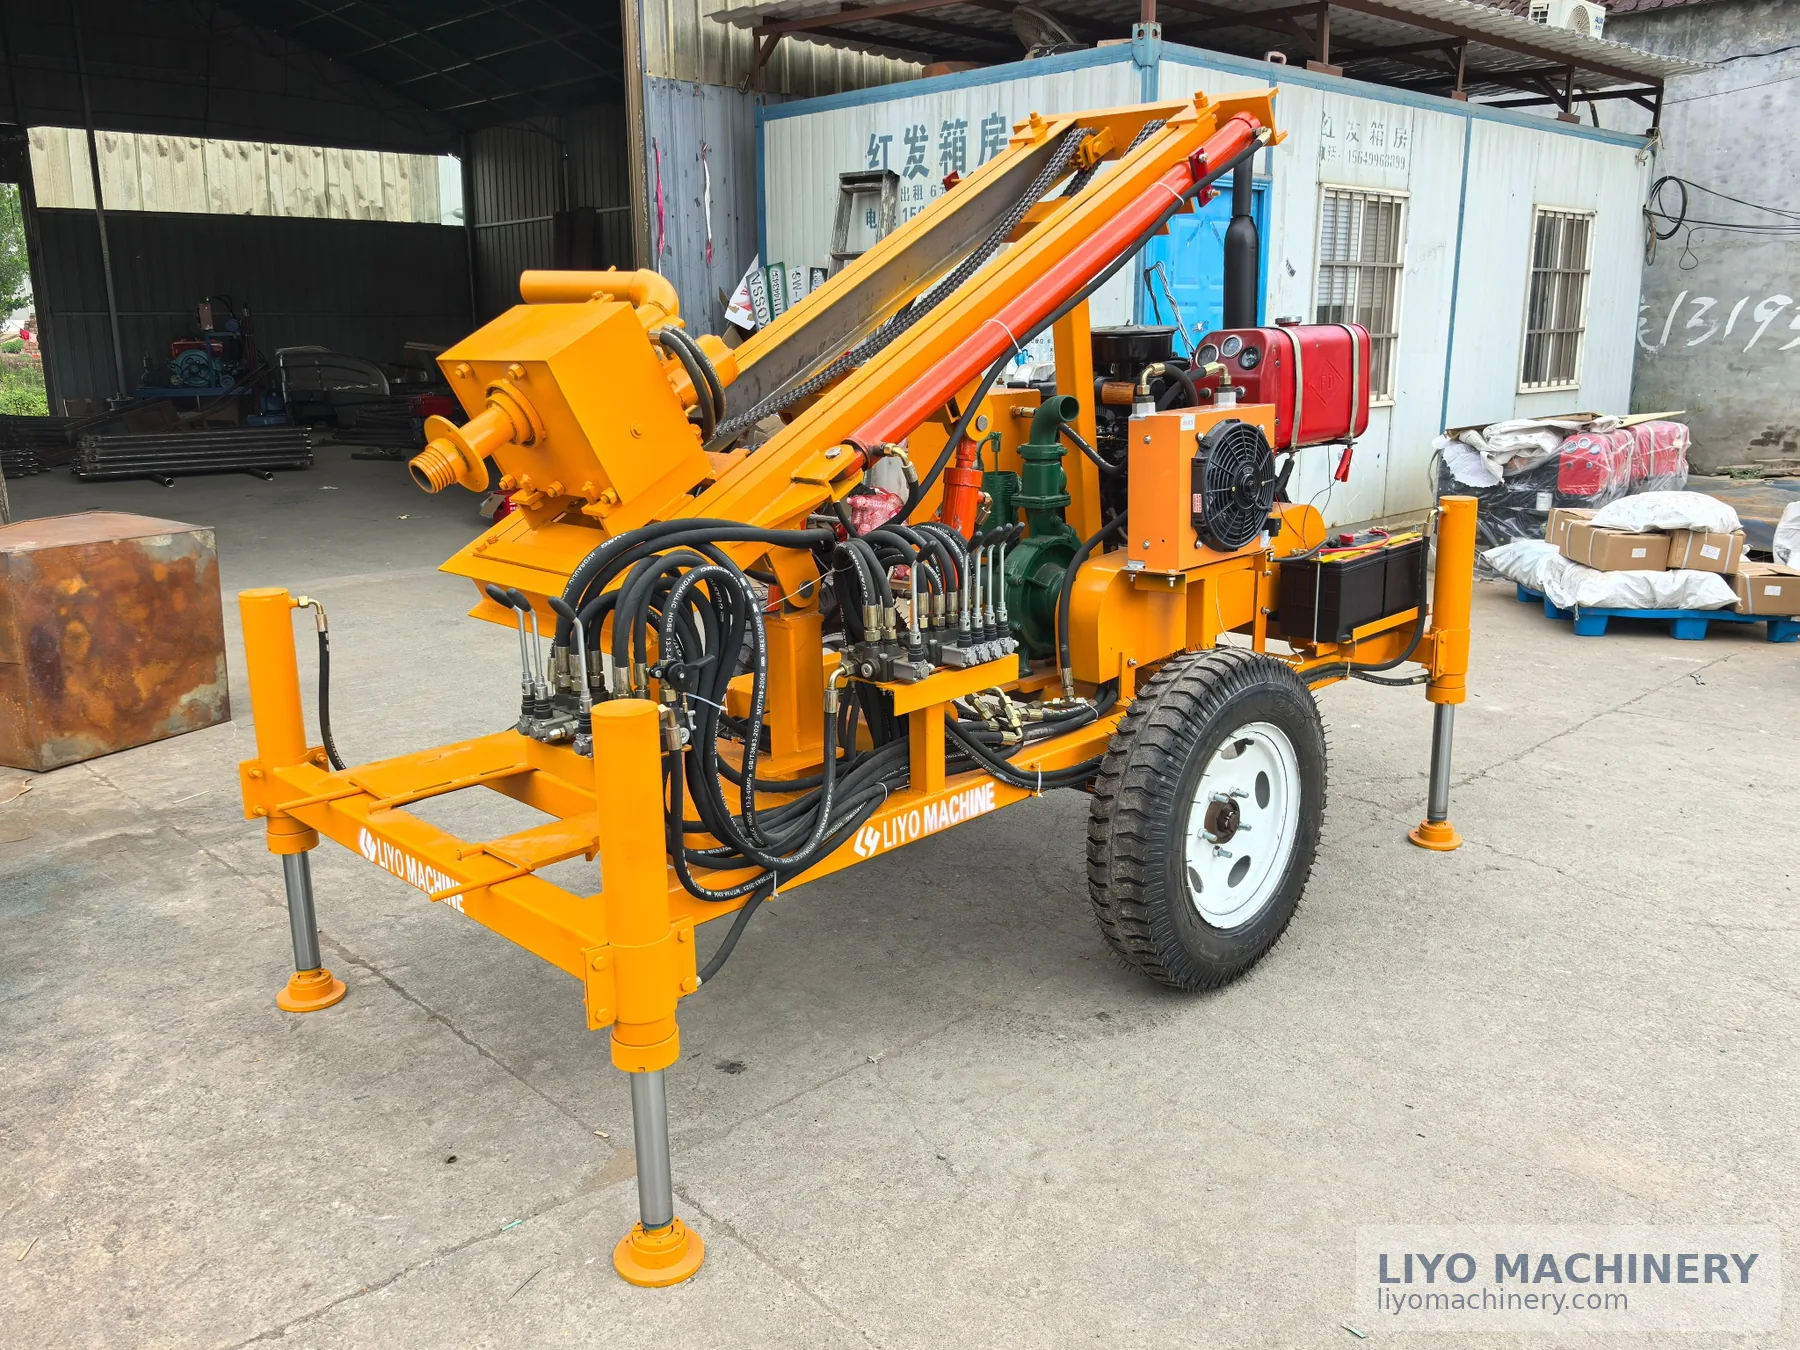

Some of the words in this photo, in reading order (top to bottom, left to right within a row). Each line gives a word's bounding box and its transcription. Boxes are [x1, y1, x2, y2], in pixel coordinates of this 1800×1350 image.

[867, 112, 1008, 180] 红发箱房
[901, 184, 923, 202] 出租
[671, 574, 695, 609] HYDRAULIC
[666, 612, 674, 633] HOSE
[883, 809, 920, 849] LIYO
[923, 781, 996, 834] MACHINE
[377, 837, 404, 878] LIYO
[405, 853, 465, 914] MACHINE
